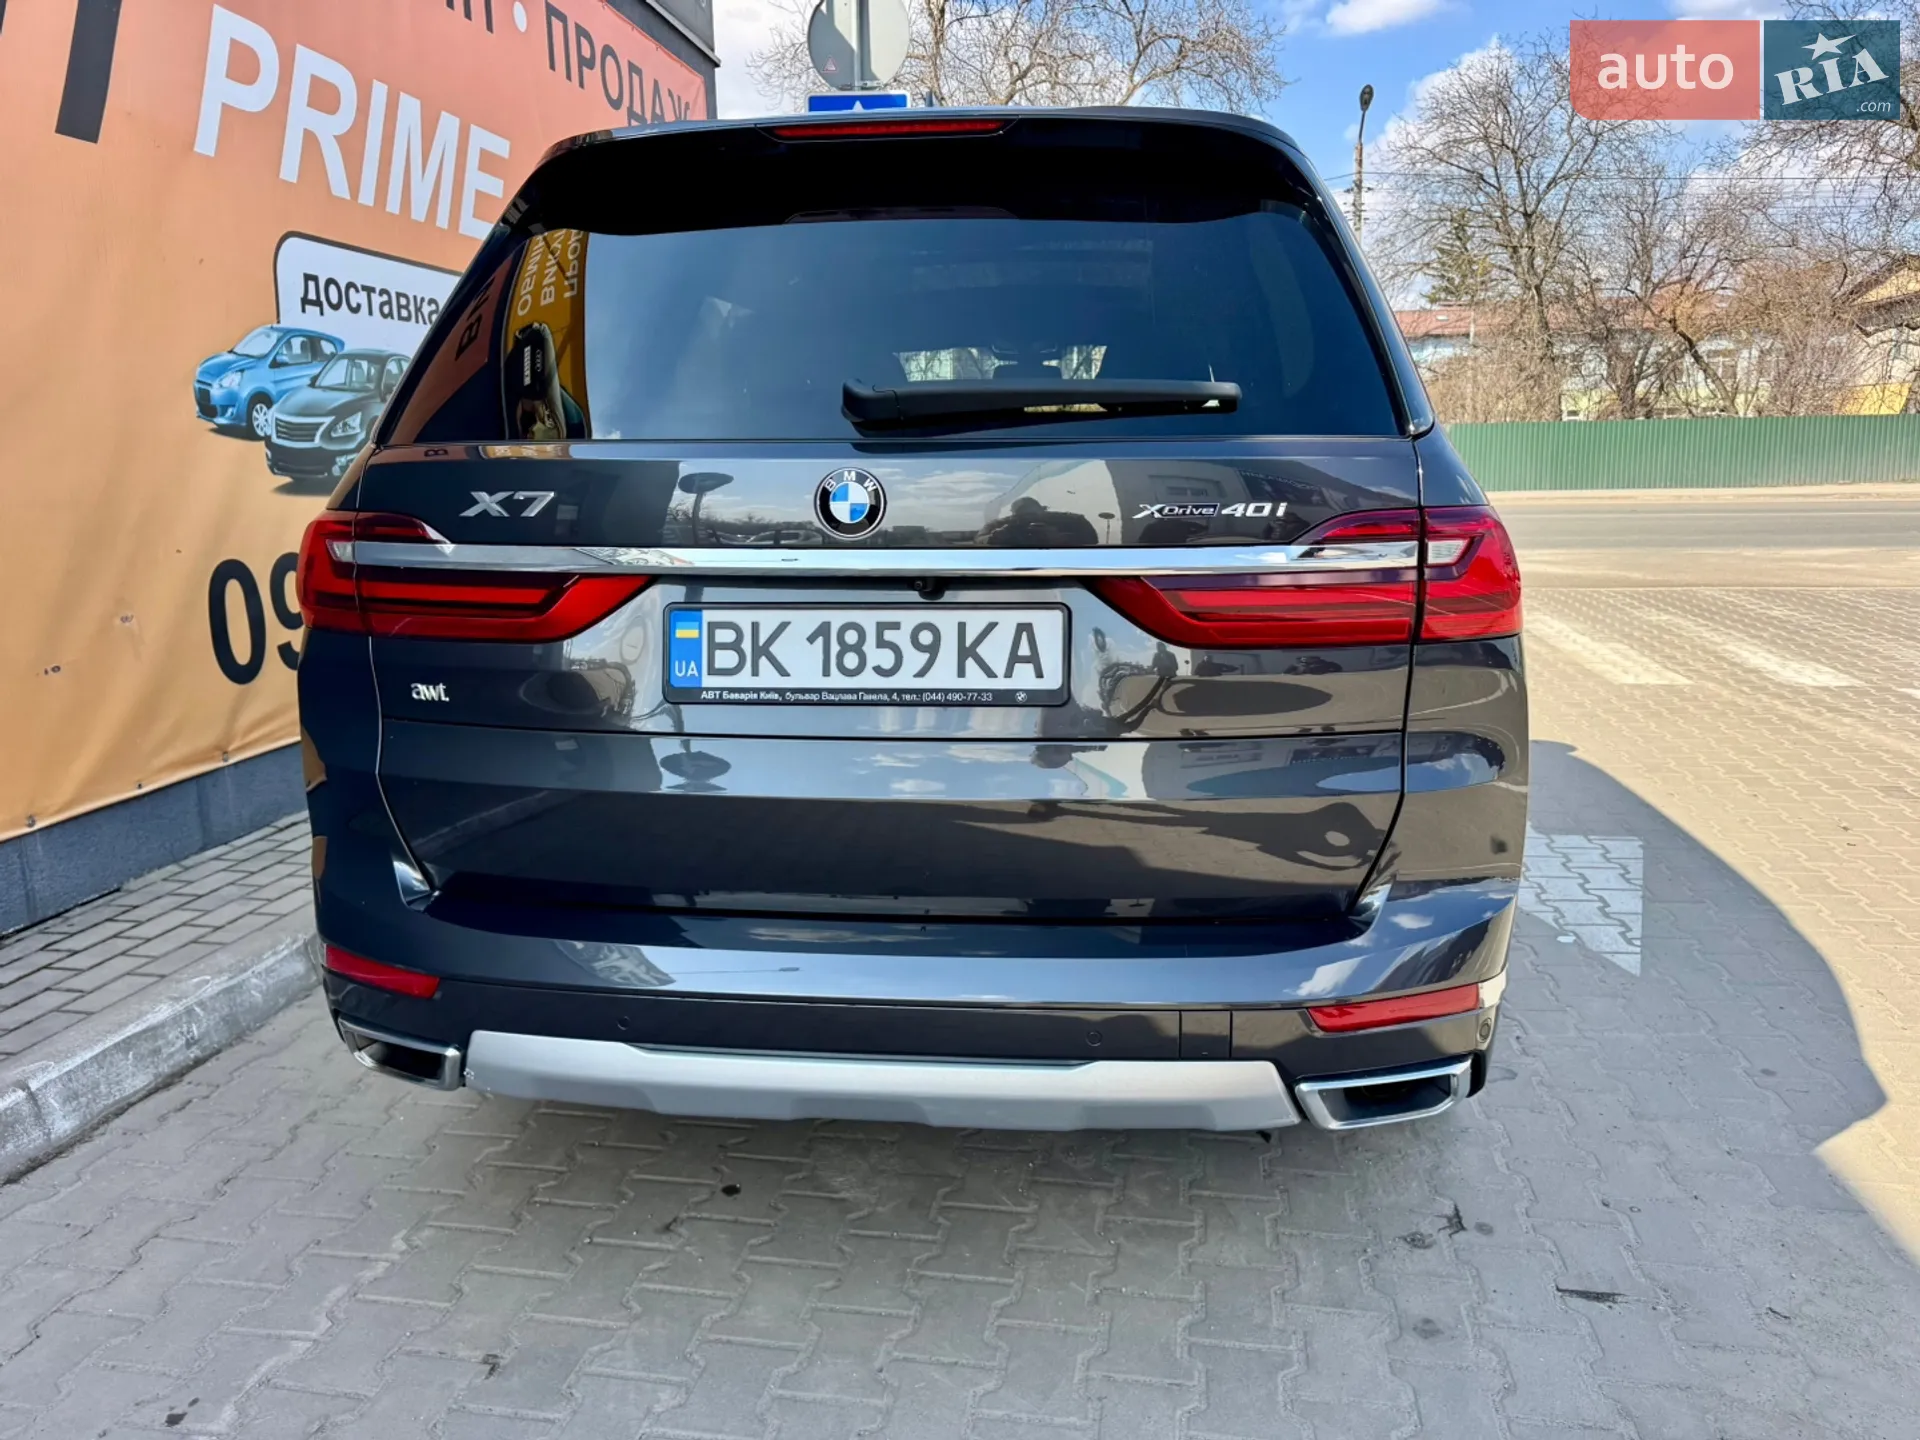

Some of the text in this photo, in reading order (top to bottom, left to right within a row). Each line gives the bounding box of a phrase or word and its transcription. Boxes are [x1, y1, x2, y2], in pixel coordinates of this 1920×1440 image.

[193, 3, 510, 240] PRIME
[300, 272, 440, 326] доставка
[824, 470, 878, 492] BMW
[459, 491, 555, 517] X7
[1221, 502, 1288, 518] 40i
[208, 552, 304, 685] 09
[706, 621, 1045, 679] BK 1859 KA
[675, 660, 699, 677] UA
[701, 690, 721, 700] АВТ
[722, 690, 758, 702] Баварія
[785, 691, 820, 702] бульвар
[821, 692, 857, 702] Вацлава
[922, 691, 945, 702] (044)
[946, 691, 993, 702] 490-77-33
